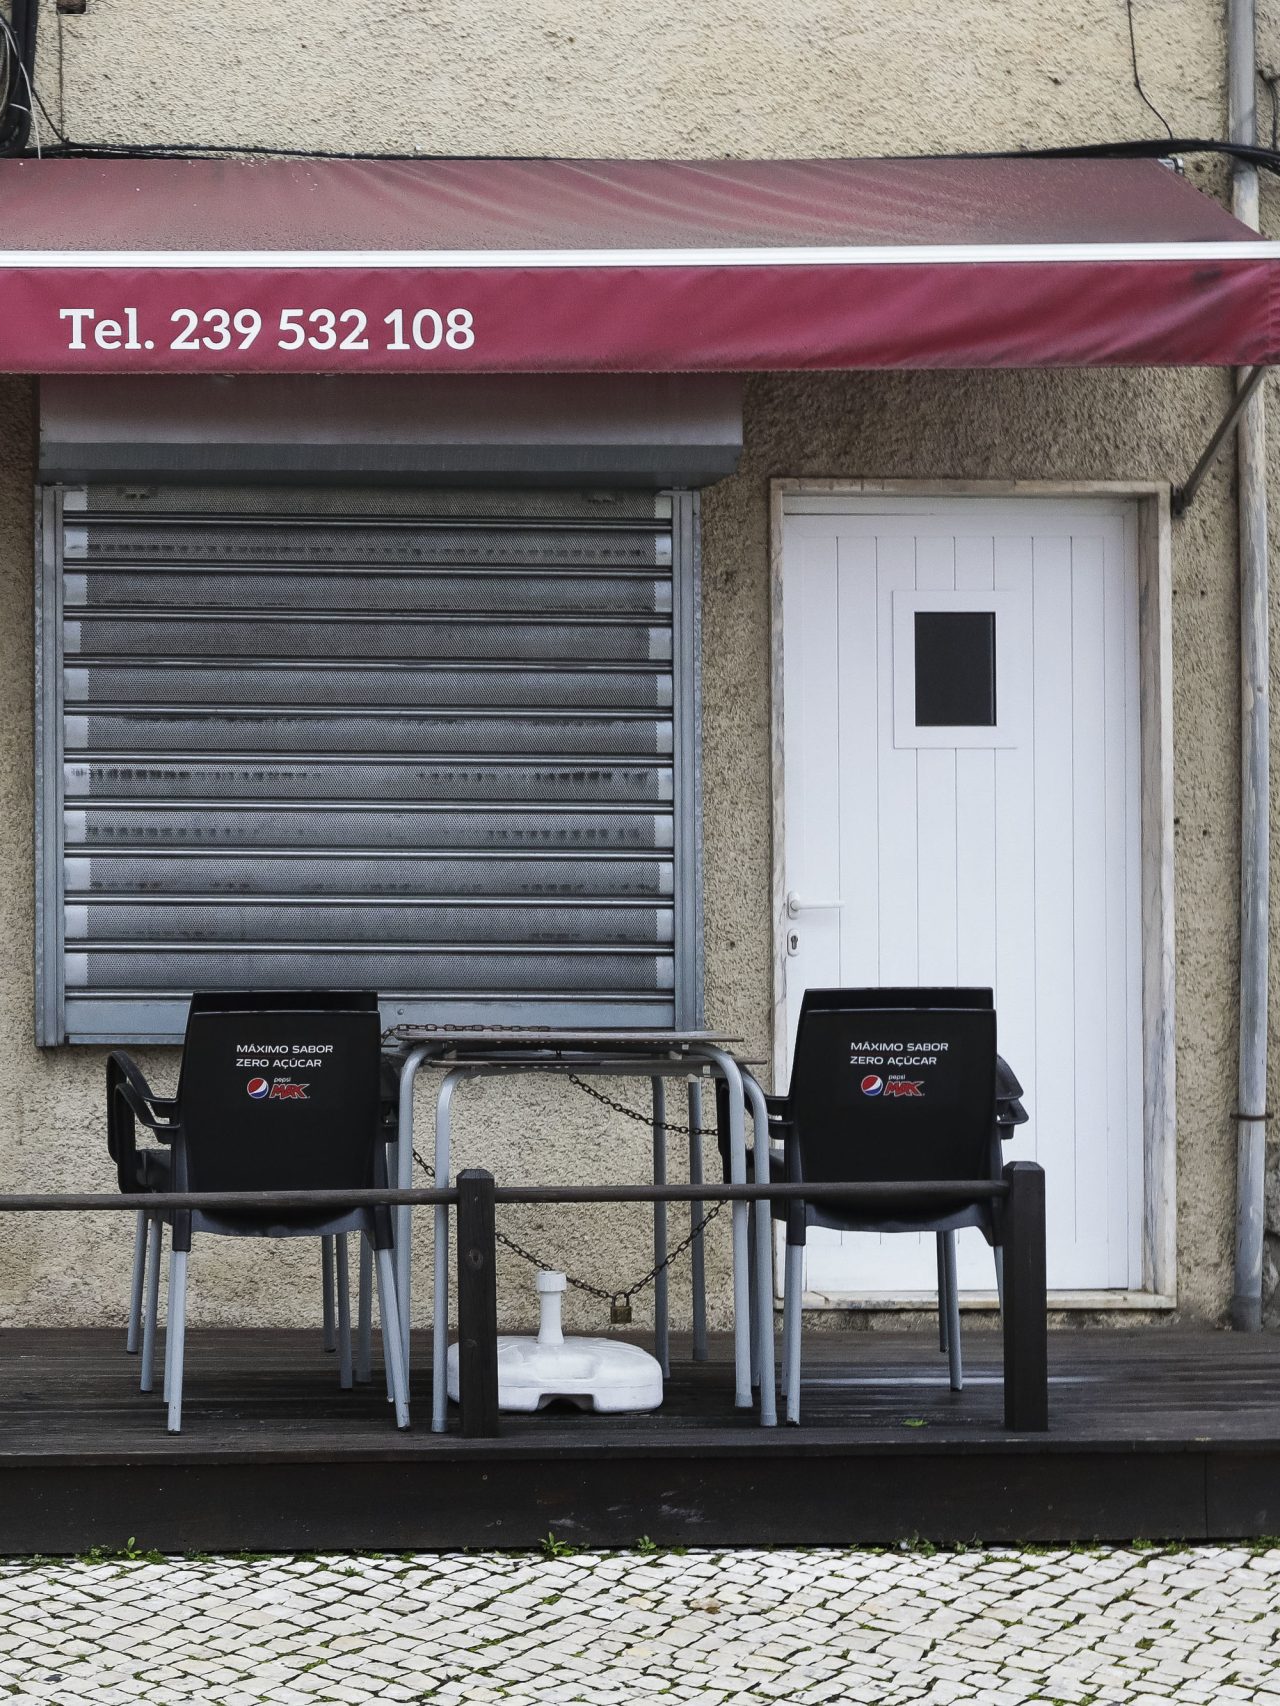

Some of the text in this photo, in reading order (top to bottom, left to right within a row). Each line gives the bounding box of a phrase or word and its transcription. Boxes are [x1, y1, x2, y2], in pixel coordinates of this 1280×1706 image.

[59, 307, 475, 351] Tel. 239 532 108
[236, 1043, 334, 1054] MÁXIMO SABOR
[850, 1041, 949, 1052] MÁXIMO SABOR
[235, 1057, 322, 1069] ZERO AÇÚCAR
[849, 1055, 937, 1067] ZERO AÇÚCAR
